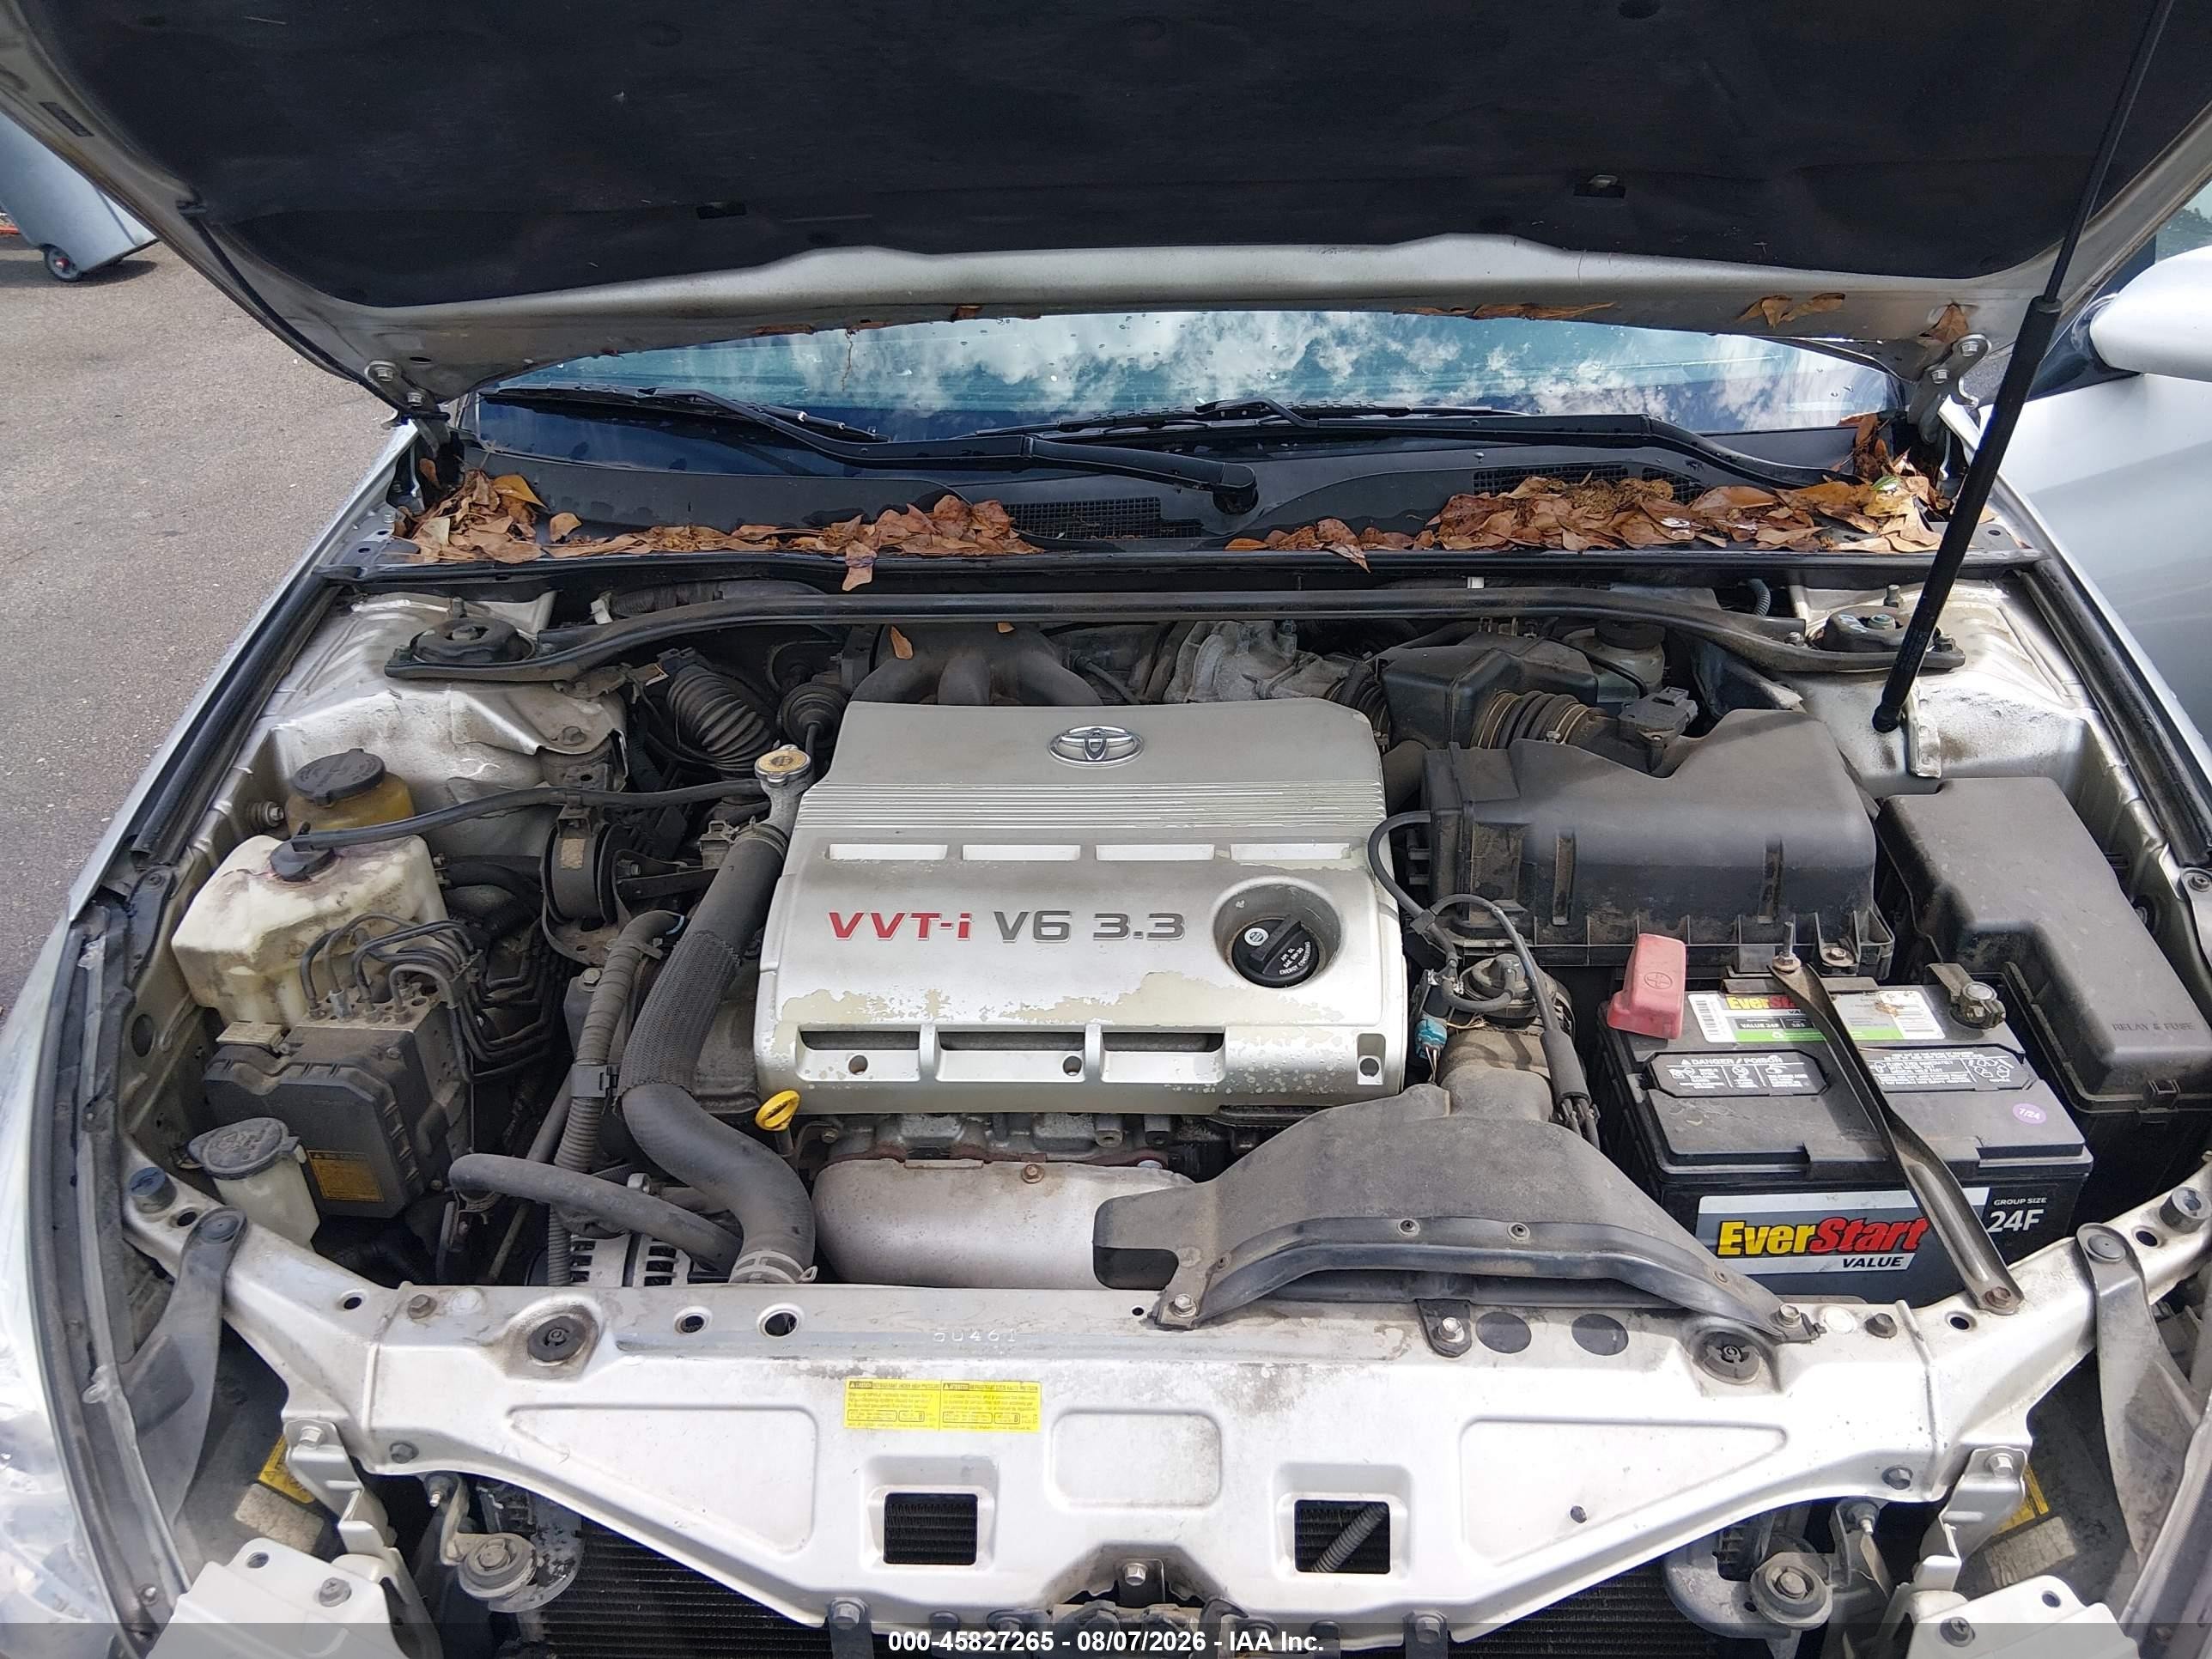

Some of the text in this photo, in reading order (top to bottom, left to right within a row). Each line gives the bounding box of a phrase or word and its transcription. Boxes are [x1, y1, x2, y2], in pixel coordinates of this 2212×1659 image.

[828, 910, 1187, 943] VVT-i V6 3.3
[2112, 1023, 2149, 1031] RELAY
[1986, 1208, 2045, 1233] 24F
[1717, 1216, 1929, 1256] EverStart
[1842, 1256, 1905, 1268] VALUE
